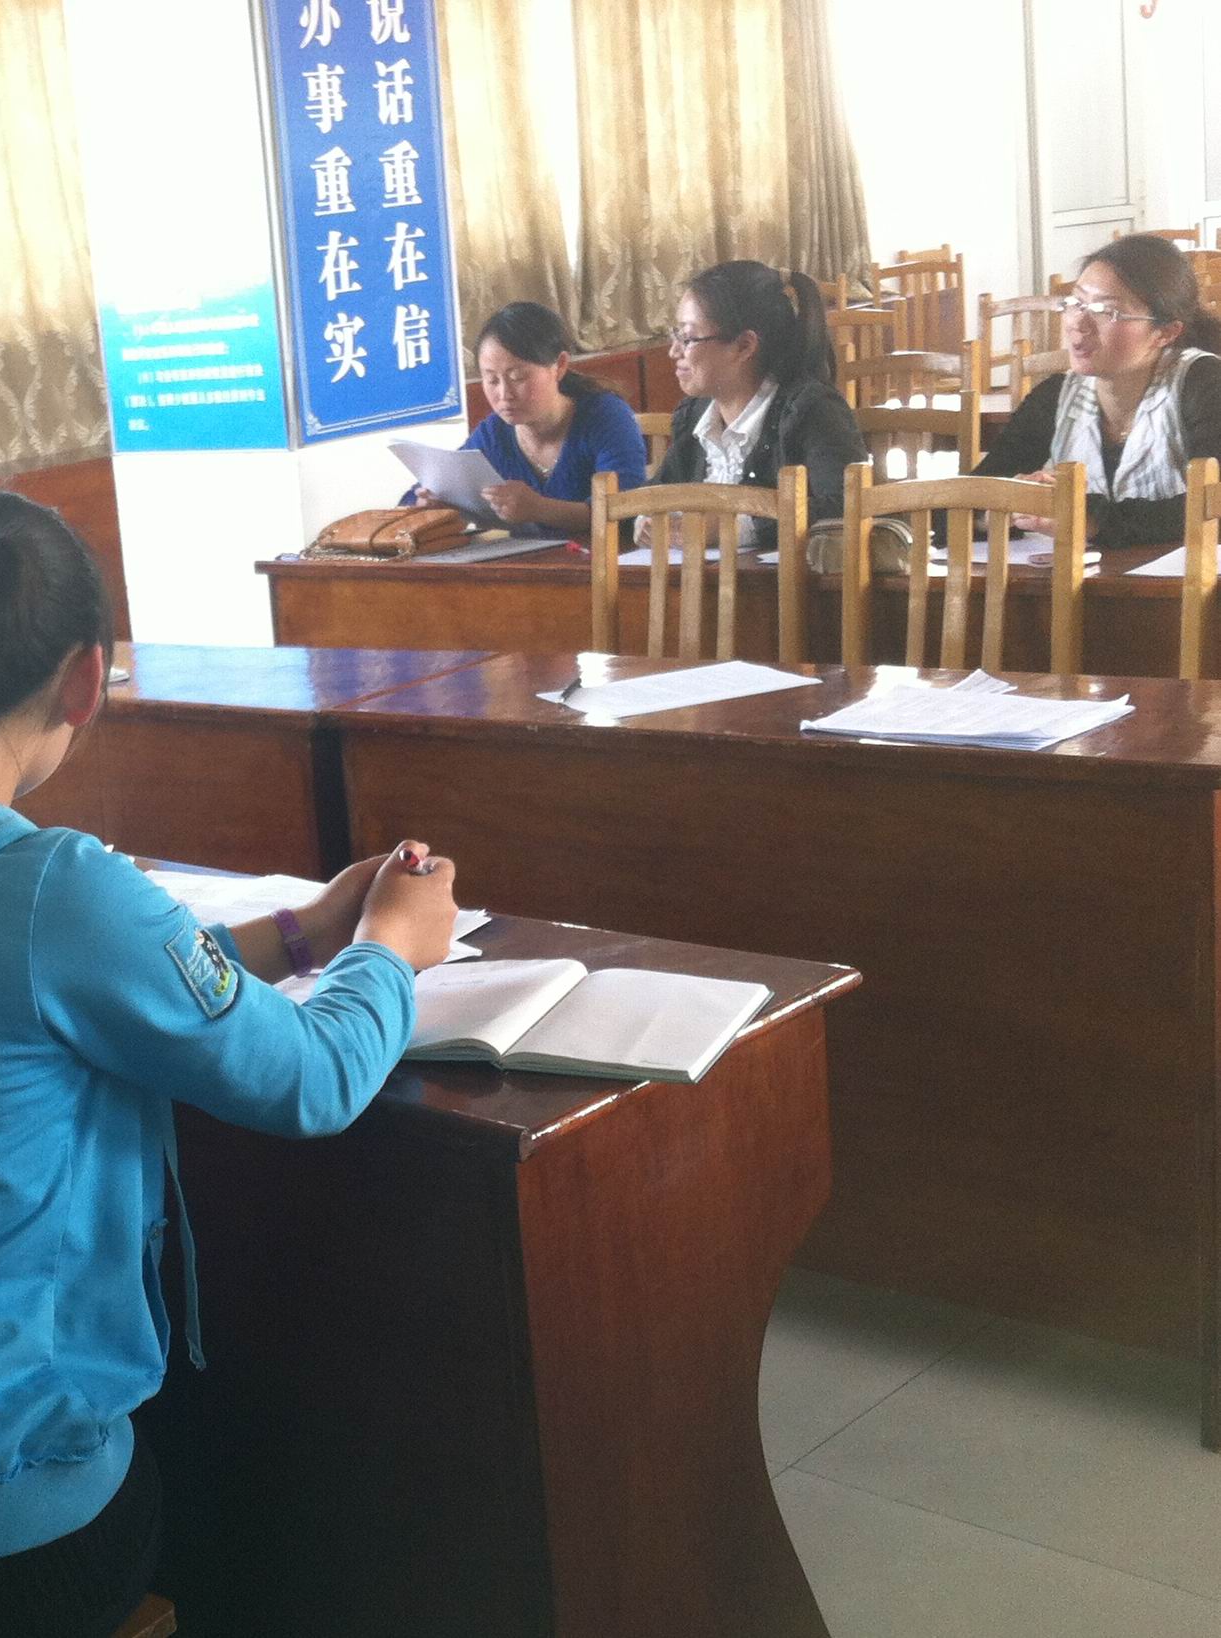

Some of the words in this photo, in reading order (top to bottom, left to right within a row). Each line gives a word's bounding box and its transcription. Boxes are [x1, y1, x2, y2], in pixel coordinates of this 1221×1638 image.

[299, 0, 368, 383] 办事重在实
[365, 0, 431, 370] 说话重在信
